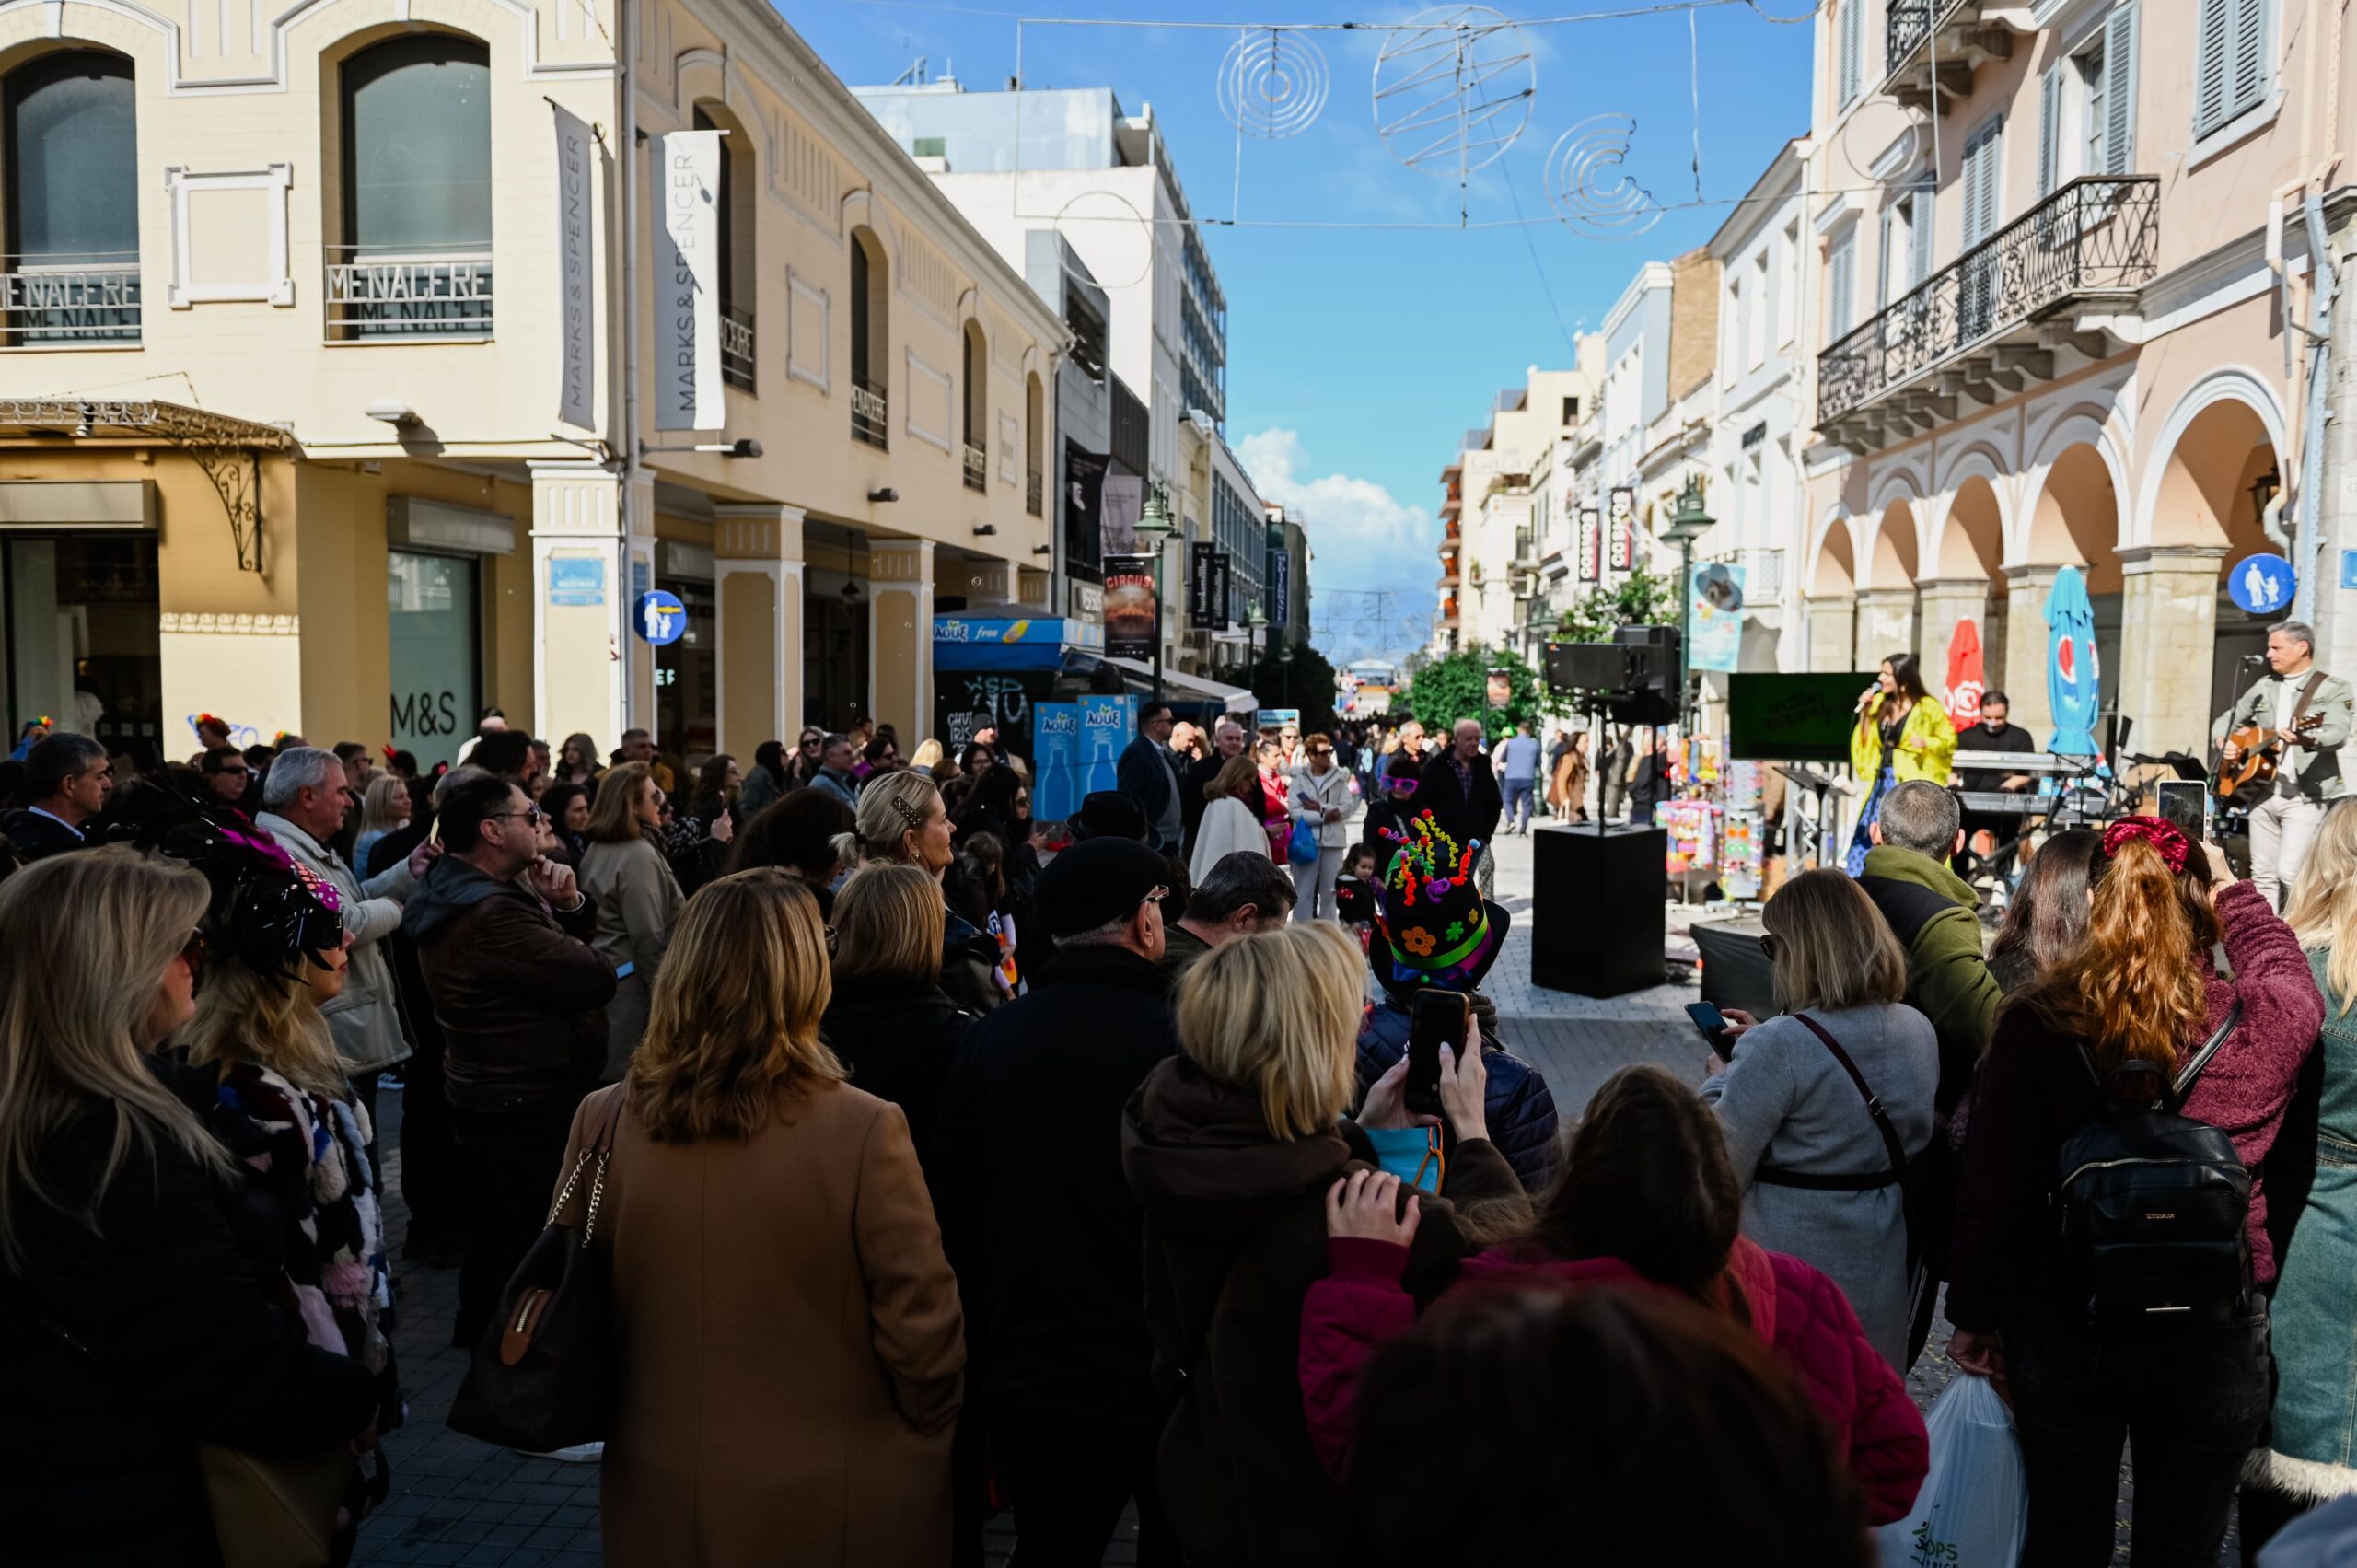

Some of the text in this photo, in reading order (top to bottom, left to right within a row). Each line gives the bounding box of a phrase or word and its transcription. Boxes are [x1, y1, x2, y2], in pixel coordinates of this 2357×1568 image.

[566, 134, 583, 408] MARKS & SPENCER
[674, 154, 696, 412] MARKS & SPENCER
[975, 626, 999, 641] free
[390, 690, 456, 739] M&S
